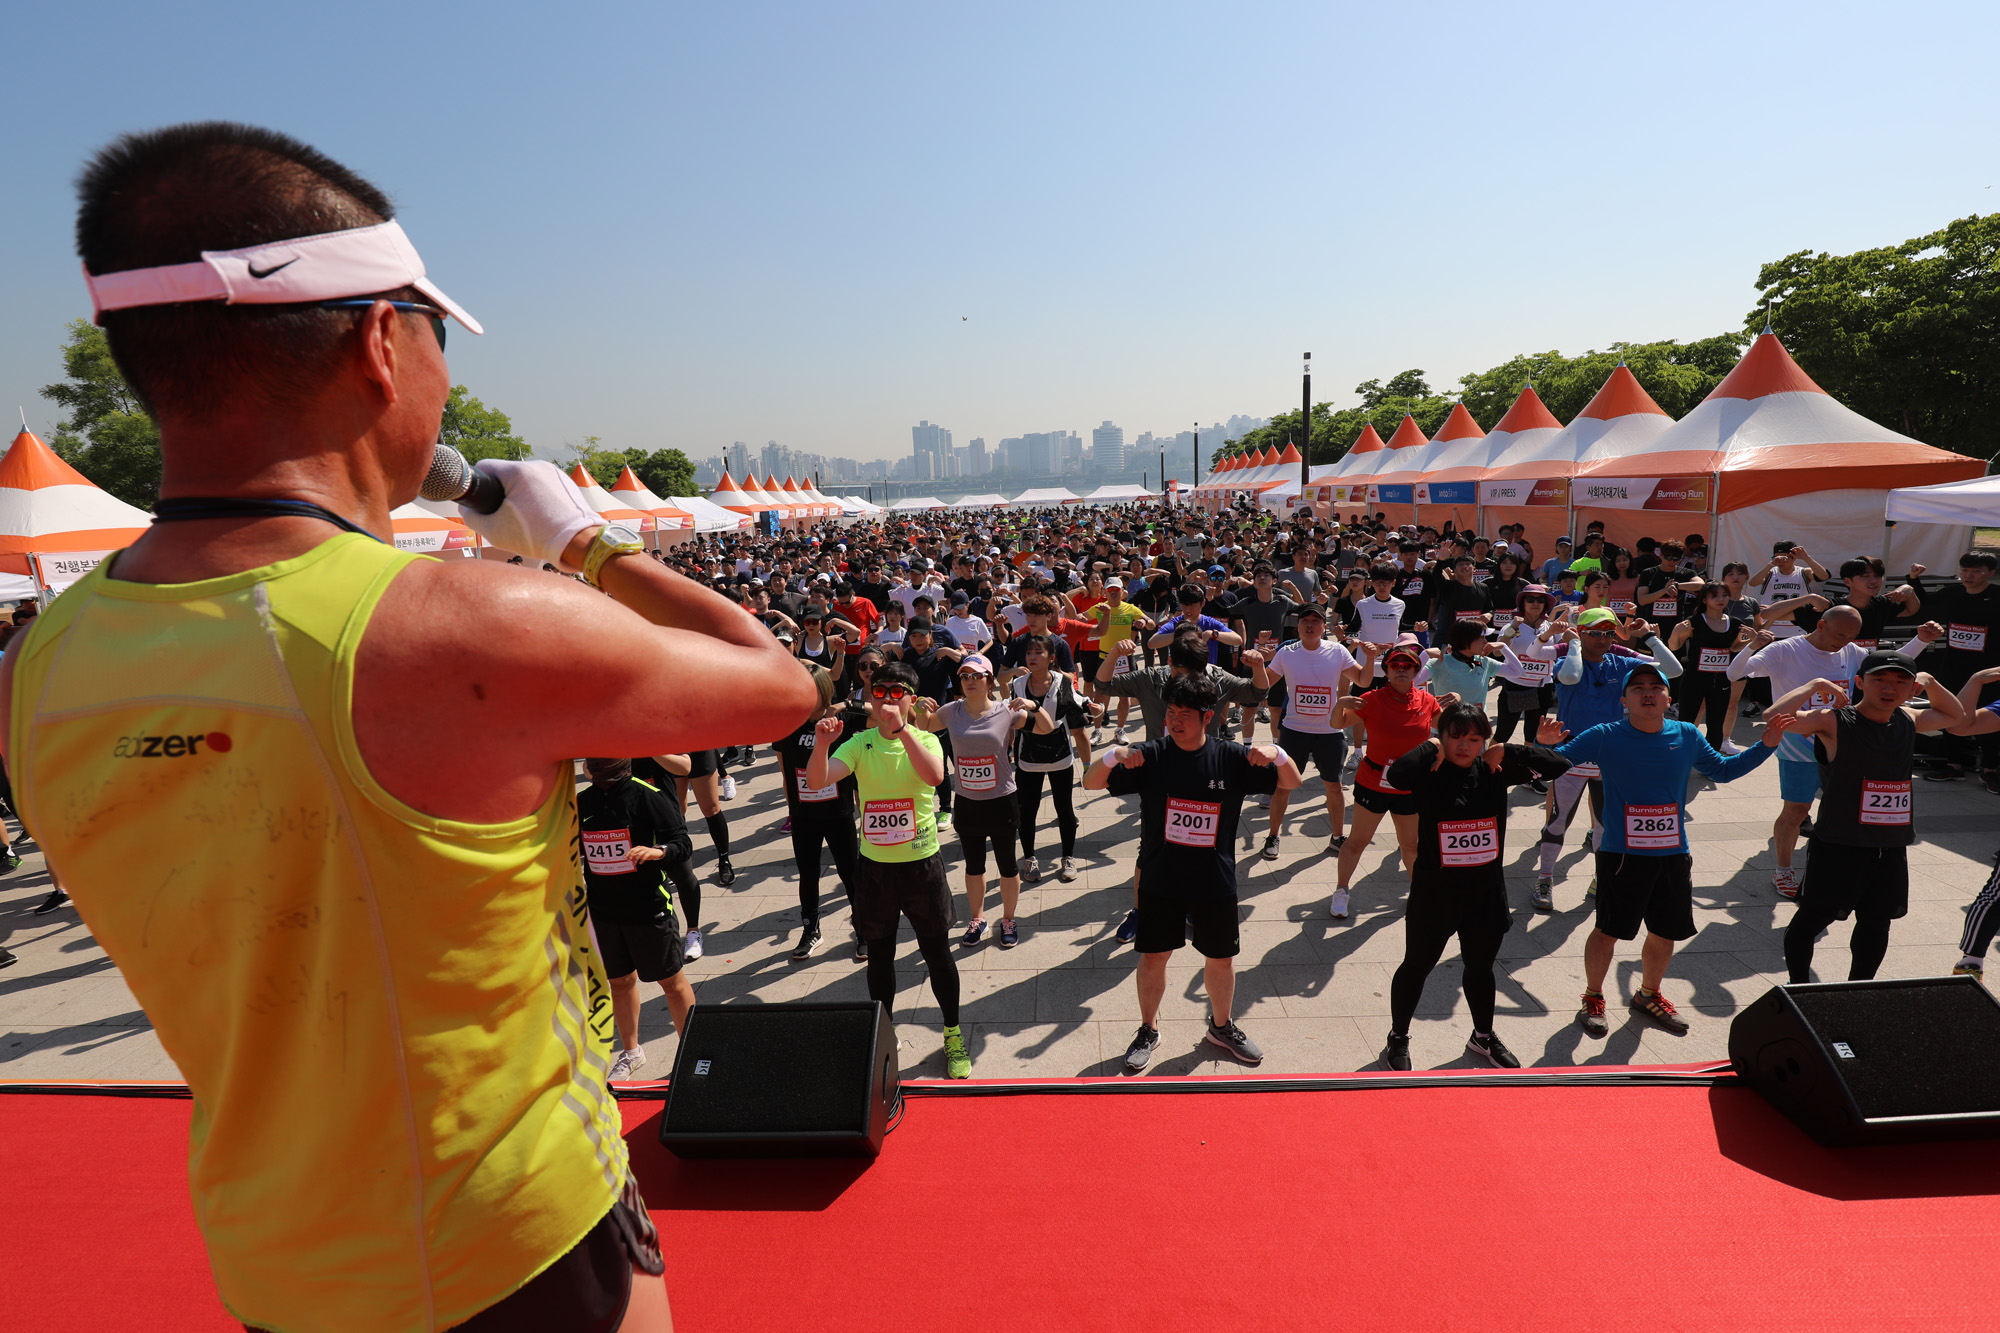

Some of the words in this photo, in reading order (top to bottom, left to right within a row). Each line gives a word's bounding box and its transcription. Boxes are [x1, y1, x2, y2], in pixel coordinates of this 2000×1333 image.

[1490, 489, 1498, 498] VIP
[1501, 488, 1516, 498] PRESS
[1534, 489, 1553, 497] Burning
[1587, 486, 1628, 499] 사회자대기실
[1657, 489, 1687, 499] Burning
[1687, 489, 1704, 498] Run
[394, 537, 436, 548] 행본부/등록확인
[1655, 602, 1675, 610] 2227
[1951, 630, 1980, 641] 2697
[1703, 655, 1728, 664] 2077
[1522, 662, 1546, 671] 2847
[1299, 694, 1327, 704] 2028
[961, 767, 991, 778] 2750
[1867, 782, 1901, 790] Burning
[1170, 800, 1202, 810] Burning
[1869, 794, 1908, 808] 2216
[1629, 806, 1663, 814] Burning
[869, 813, 909, 828] 2806
[1172, 813, 1211, 829] 2001
[1633, 818, 1675, 832] 2862
[1447, 832, 1491, 848] 2605
[588, 844, 625, 857] 2415
